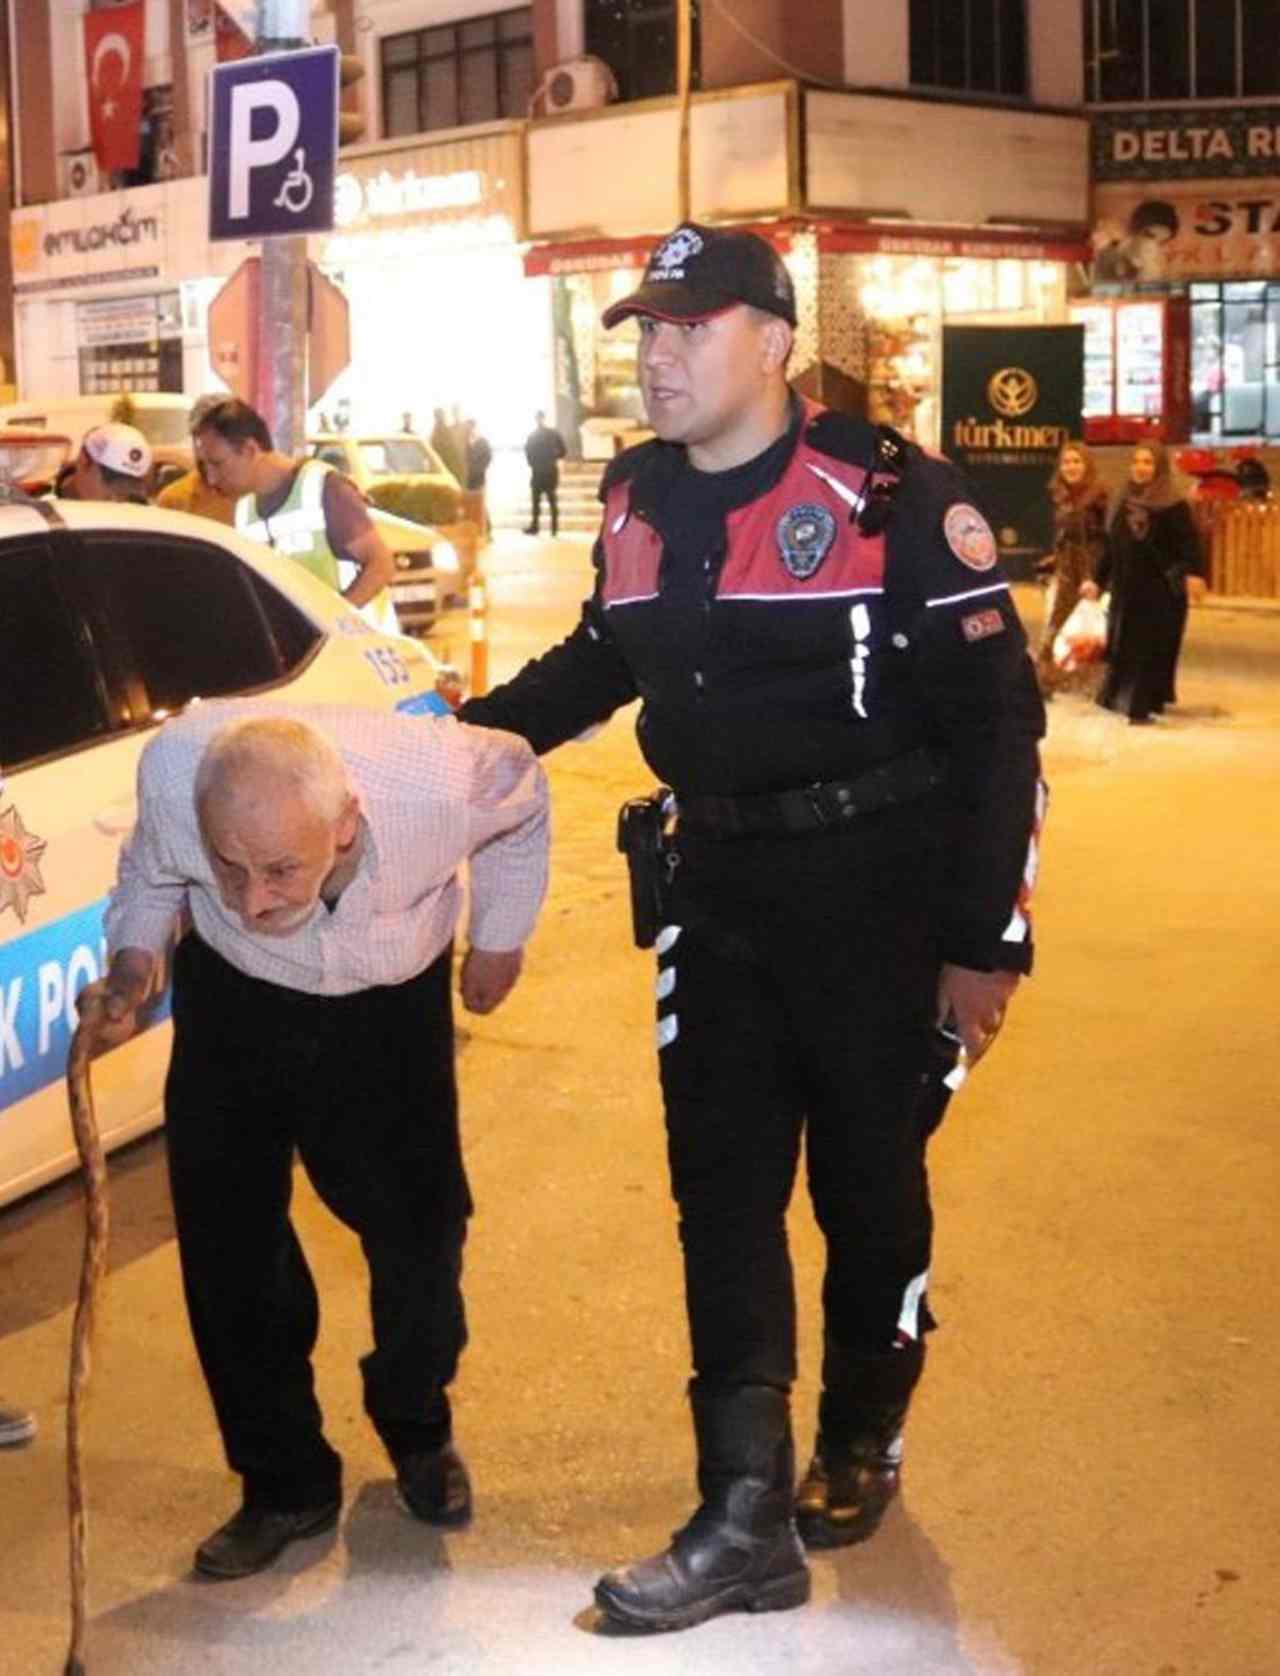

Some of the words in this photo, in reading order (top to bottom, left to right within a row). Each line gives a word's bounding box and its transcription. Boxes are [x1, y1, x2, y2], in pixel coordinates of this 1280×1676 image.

[228, 79, 301, 220] P
[1113, 127, 1234, 161] DELTA
[1193, 200, 1280, 237] ST
